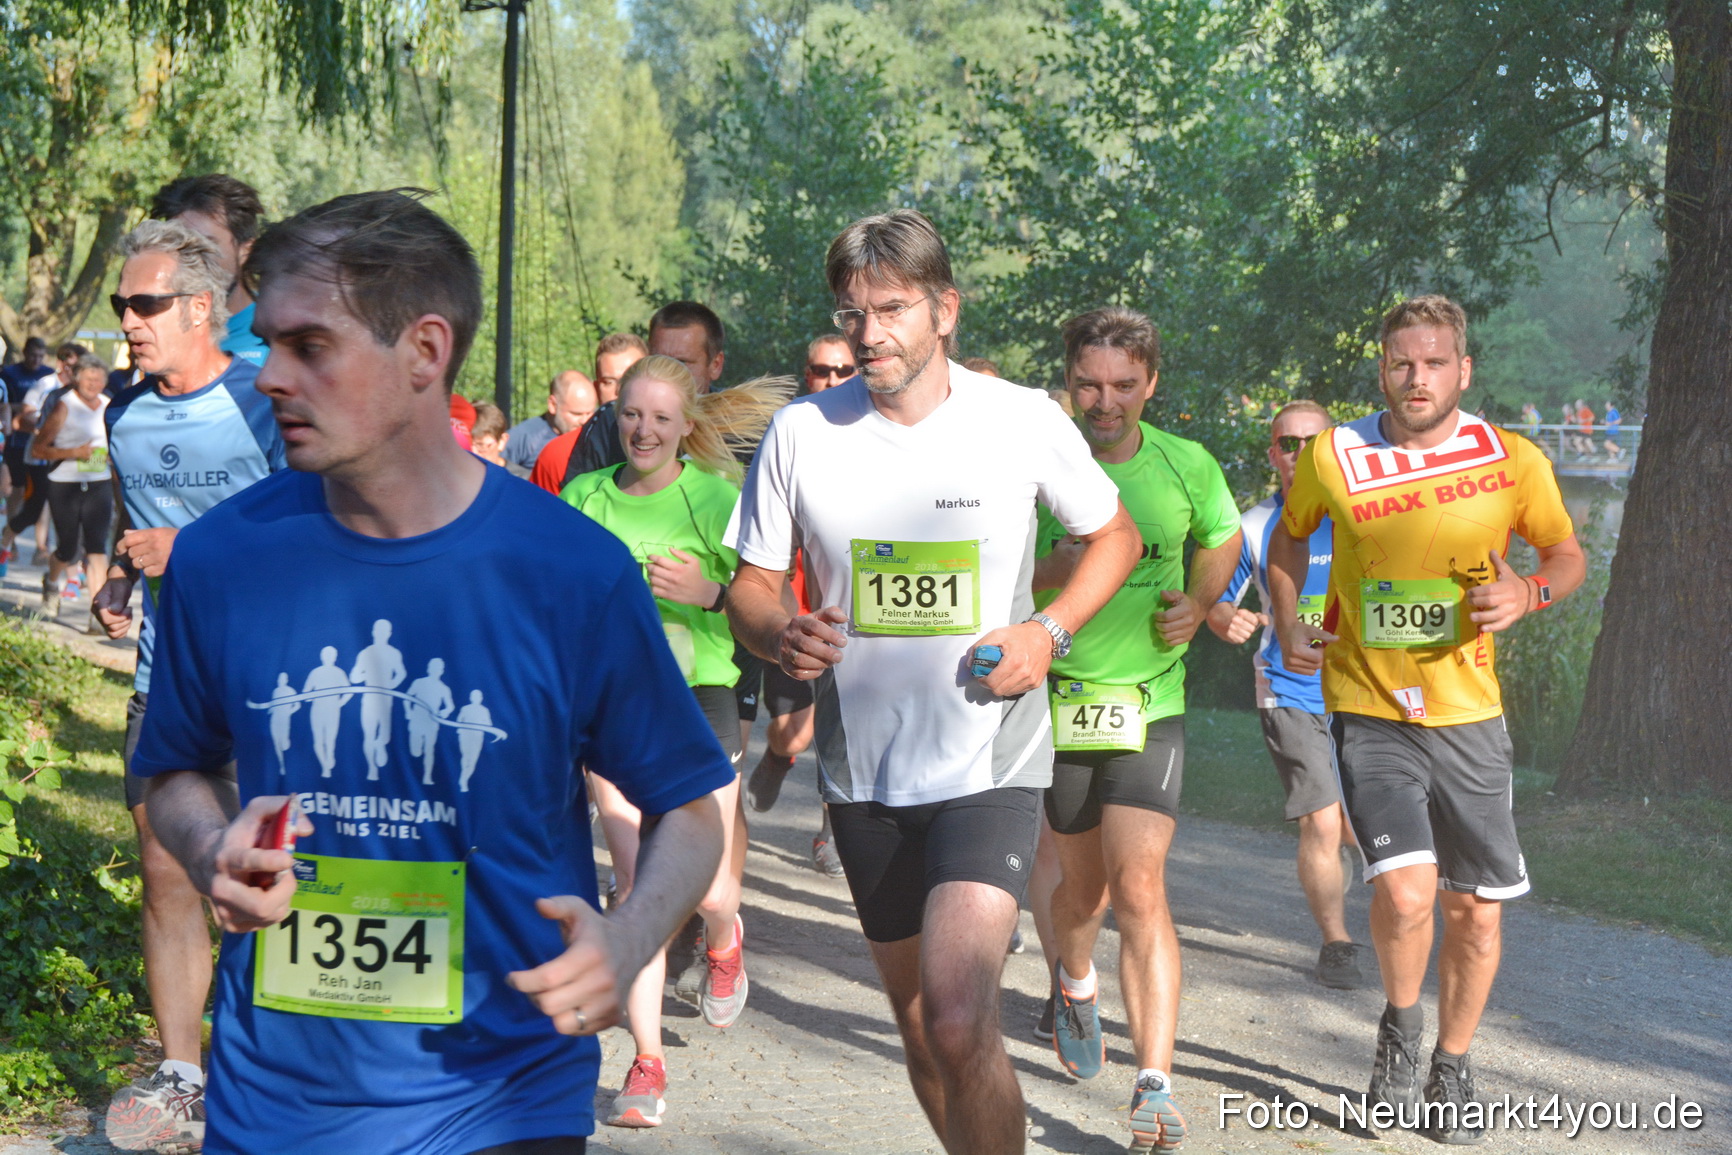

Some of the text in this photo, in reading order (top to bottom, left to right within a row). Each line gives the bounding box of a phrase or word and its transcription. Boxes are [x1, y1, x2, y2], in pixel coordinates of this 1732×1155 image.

[935, 498, 981, 509] Markus
[1351, 470, 1515, 524] MAX BÖGL
[868, 573, 958, 608] 1381
[881, 608, 950, 619] Felner Markus
[1373, 603, 1446, 628] 1309
[1405, 629, 1435, 637] Kersten
[1072, 705, 1125, 729] 475
[299, 792, 457, 826] GEMEINSAM
[336, 821, 421, 840] INS ZIEL
[1373, 834, 1391, 848] KG
[279, 909, 432, 975] 1354
[318, 973, 382, 991] Reh Jan
[308, 988, 392, 1004] Medaktiv GmbH
